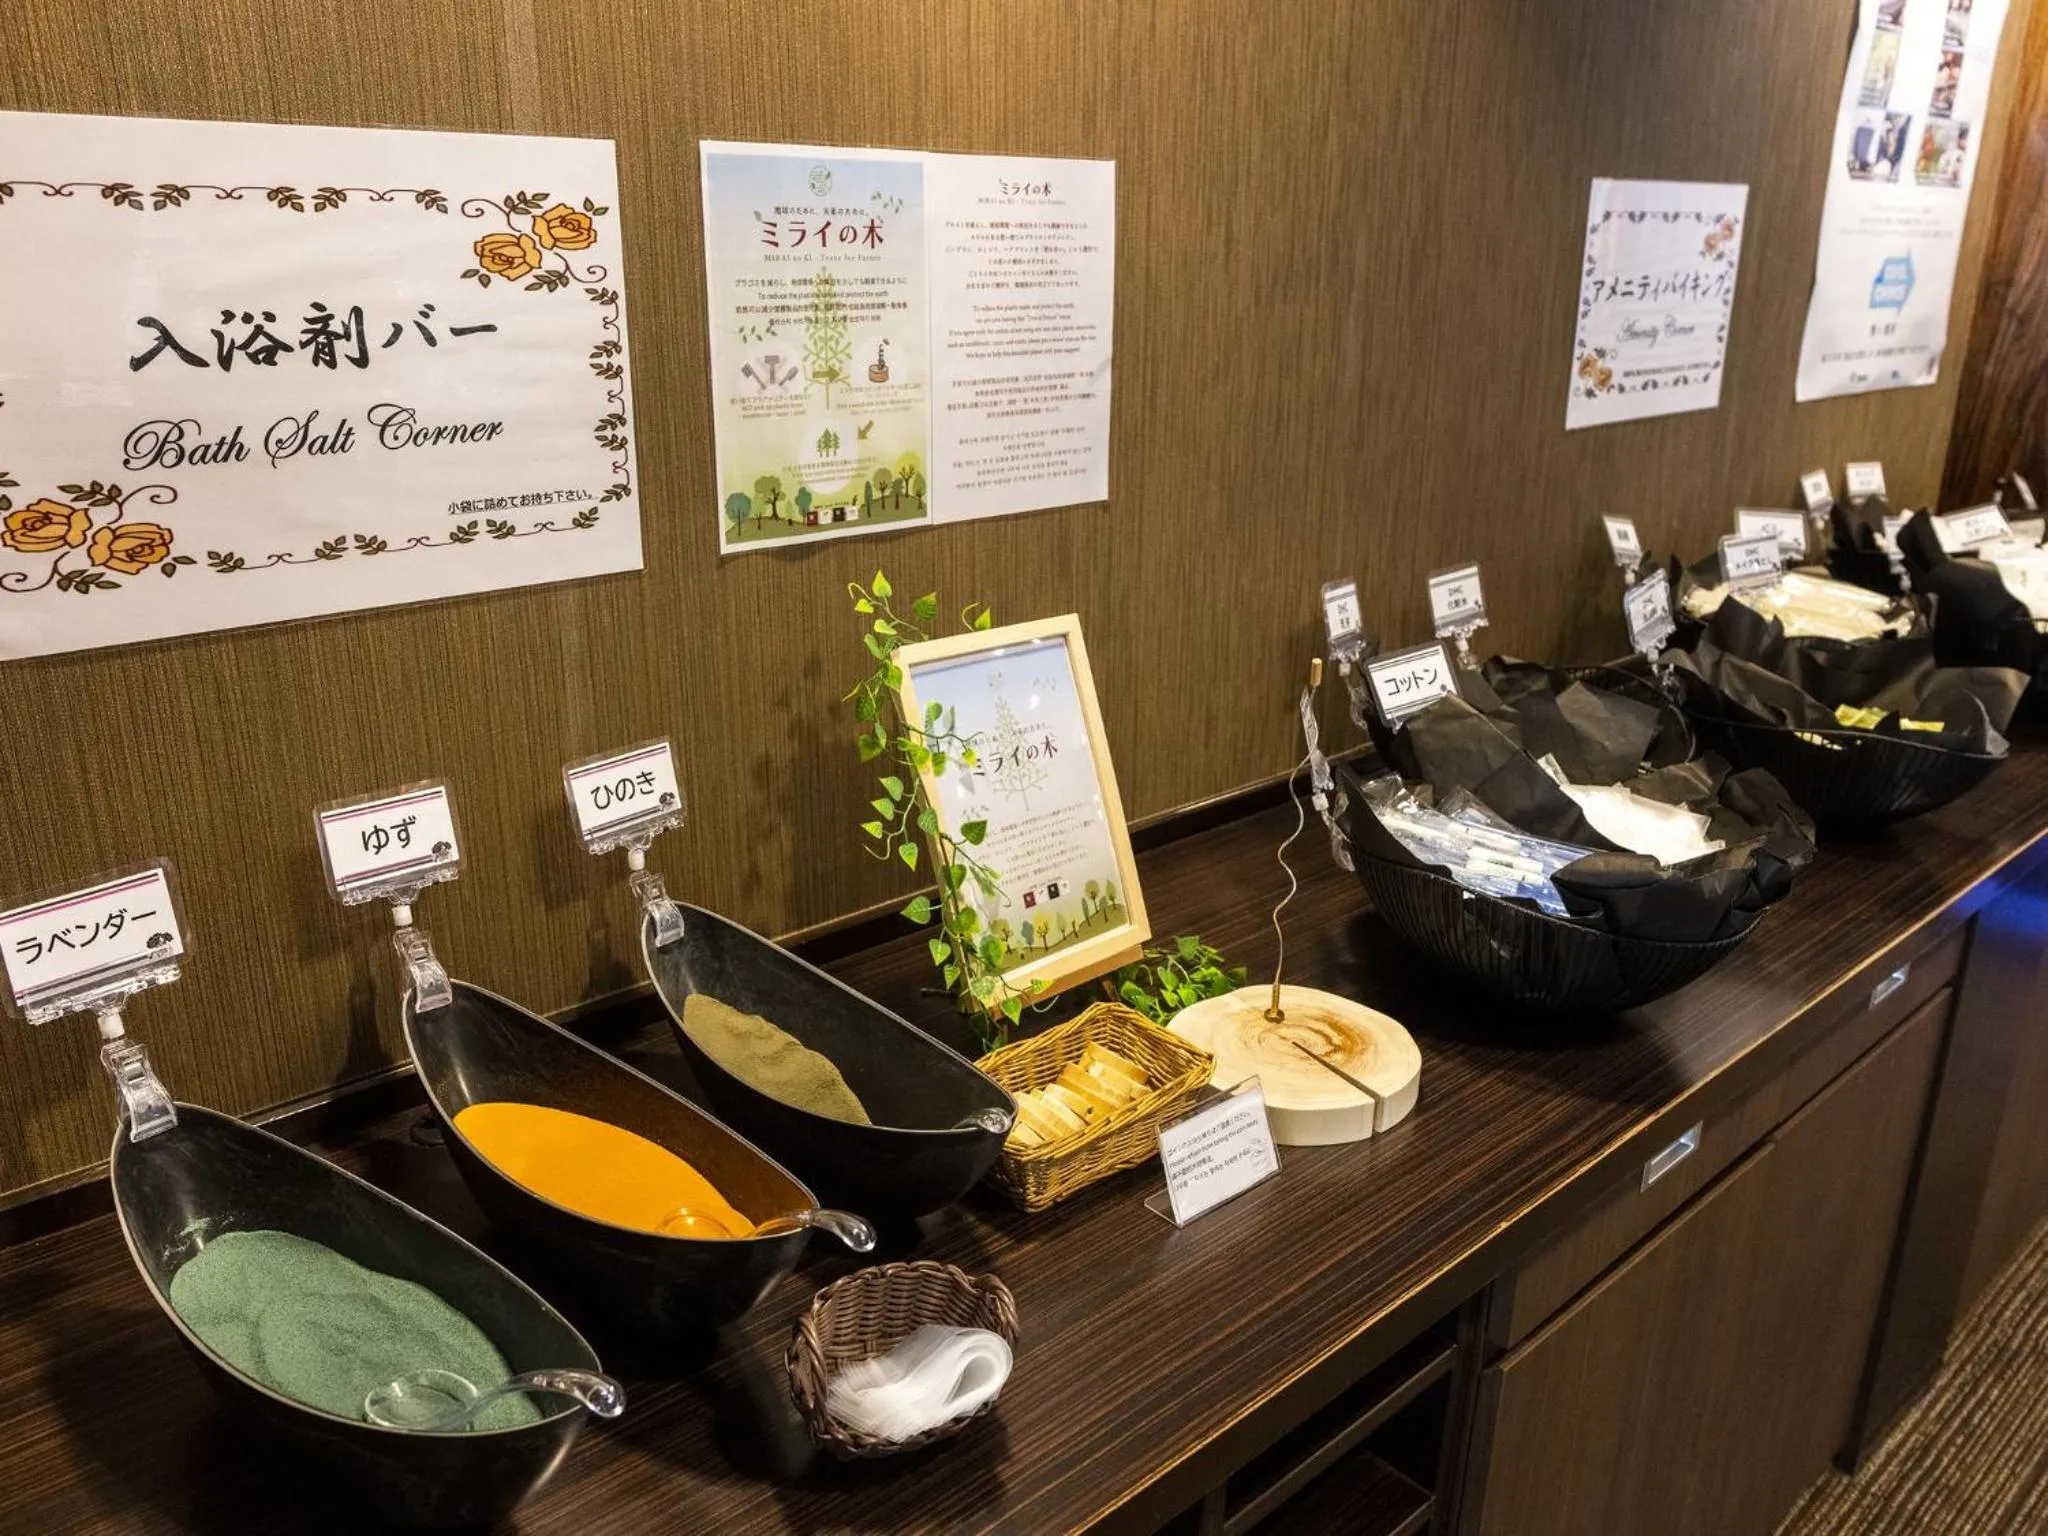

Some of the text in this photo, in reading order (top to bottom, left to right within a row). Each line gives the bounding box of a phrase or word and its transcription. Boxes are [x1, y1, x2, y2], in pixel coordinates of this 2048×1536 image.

[1000, 182, 1051, 196] ミライの木
[761, 219, 884, 249] ミライの木
[1592, 271, 1728, 302] アメニティバイキング
[129, 302, 498, 372] 入浴剤バー
[123, 403, 503, 471] Bath Salt Corner
[448, 490, 593, 514] 小袋に詰めてお持ち下さい。
[1384, 669, 1438, 696] コットン
[972, 736, 1058, 776] ミライの木
[590, 770, 657, 810] ひのき
[361, 816, 417, 856] ゆず
[16, 909, 157, 964] ラベンダー
